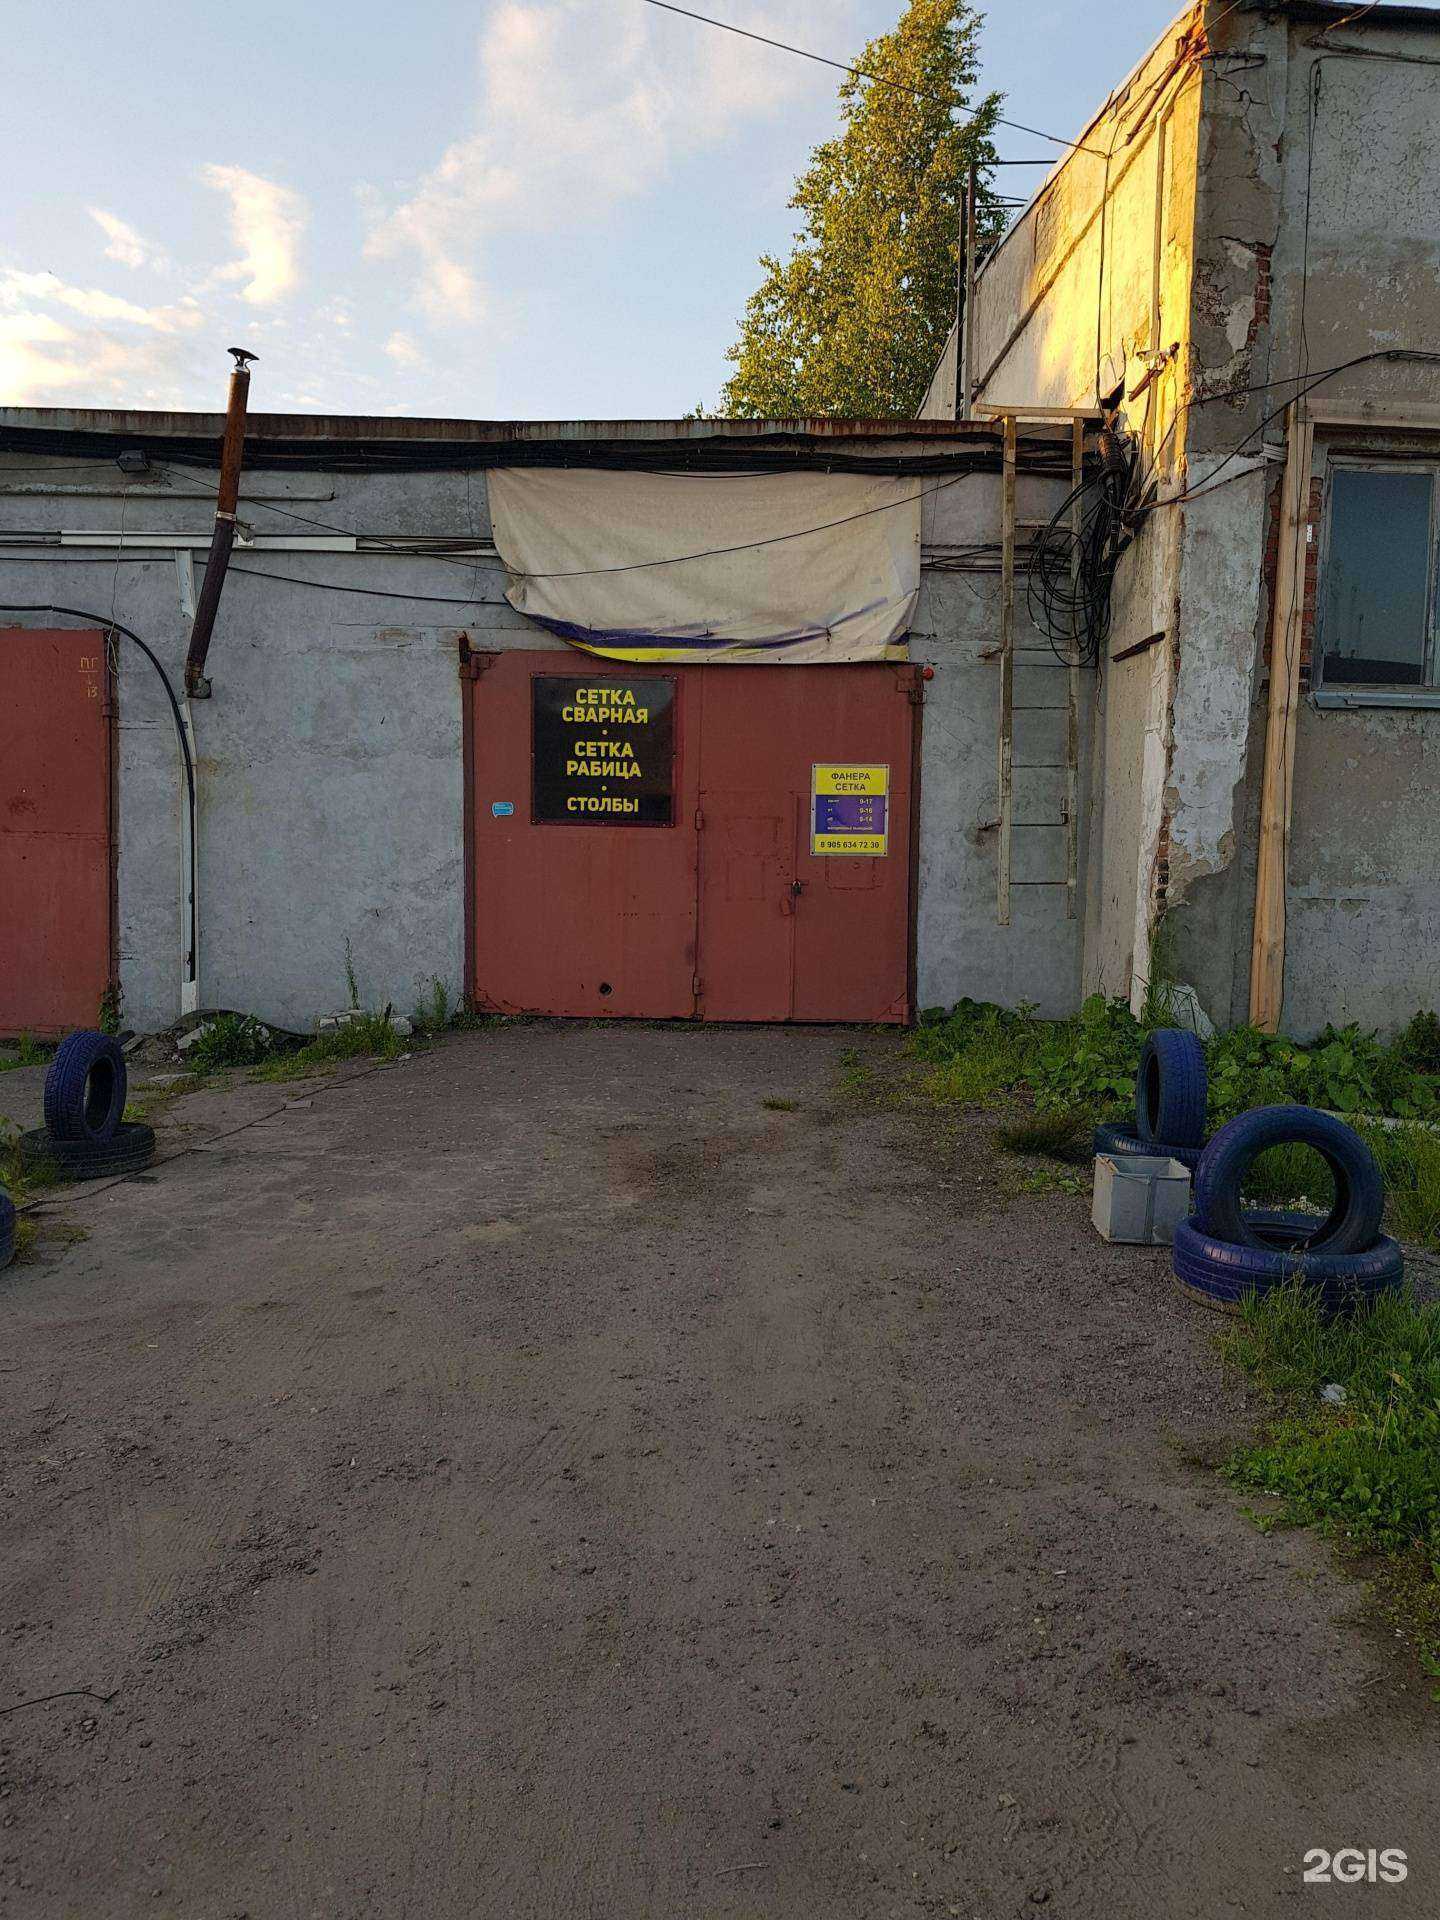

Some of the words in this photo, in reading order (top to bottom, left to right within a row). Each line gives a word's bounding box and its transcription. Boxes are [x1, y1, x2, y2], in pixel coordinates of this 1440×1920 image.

[575, 688, 636, 705] СЕТКА
[562, 707, 649, 724] СВАРНАЯ
[574, 741, 634, 758] СЕТКА
[566, 760, 642, 779] РАБИЦА
[831, 772, 871, 781] ФАНЕРА
[835, 783, 866, 791] СЕТКА
[567, 797, 639, 813] СТОЛБЫ
